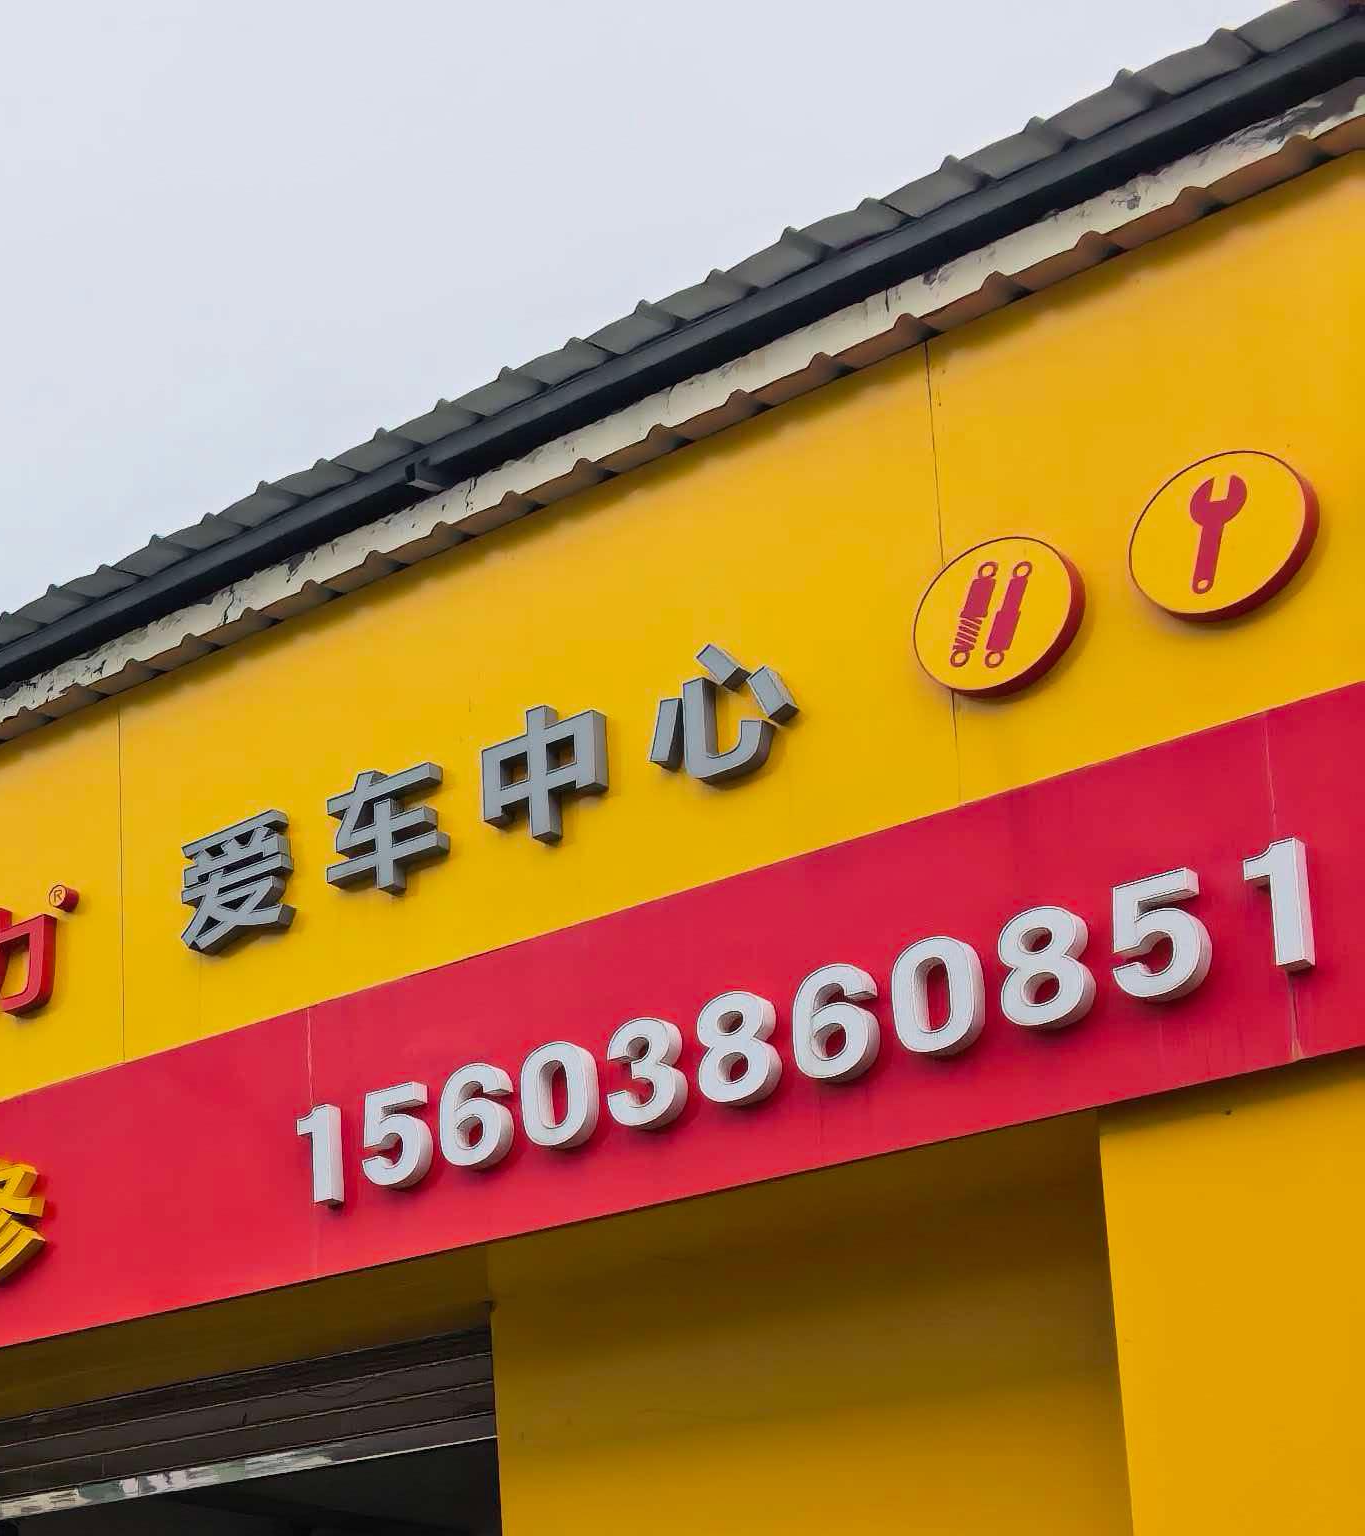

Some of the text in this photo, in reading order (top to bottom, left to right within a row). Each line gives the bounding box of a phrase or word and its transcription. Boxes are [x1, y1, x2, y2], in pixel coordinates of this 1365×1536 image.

[179, 643, 801, 955] 爱车中心
[294, 836, 1317, 1208] 15603860851
